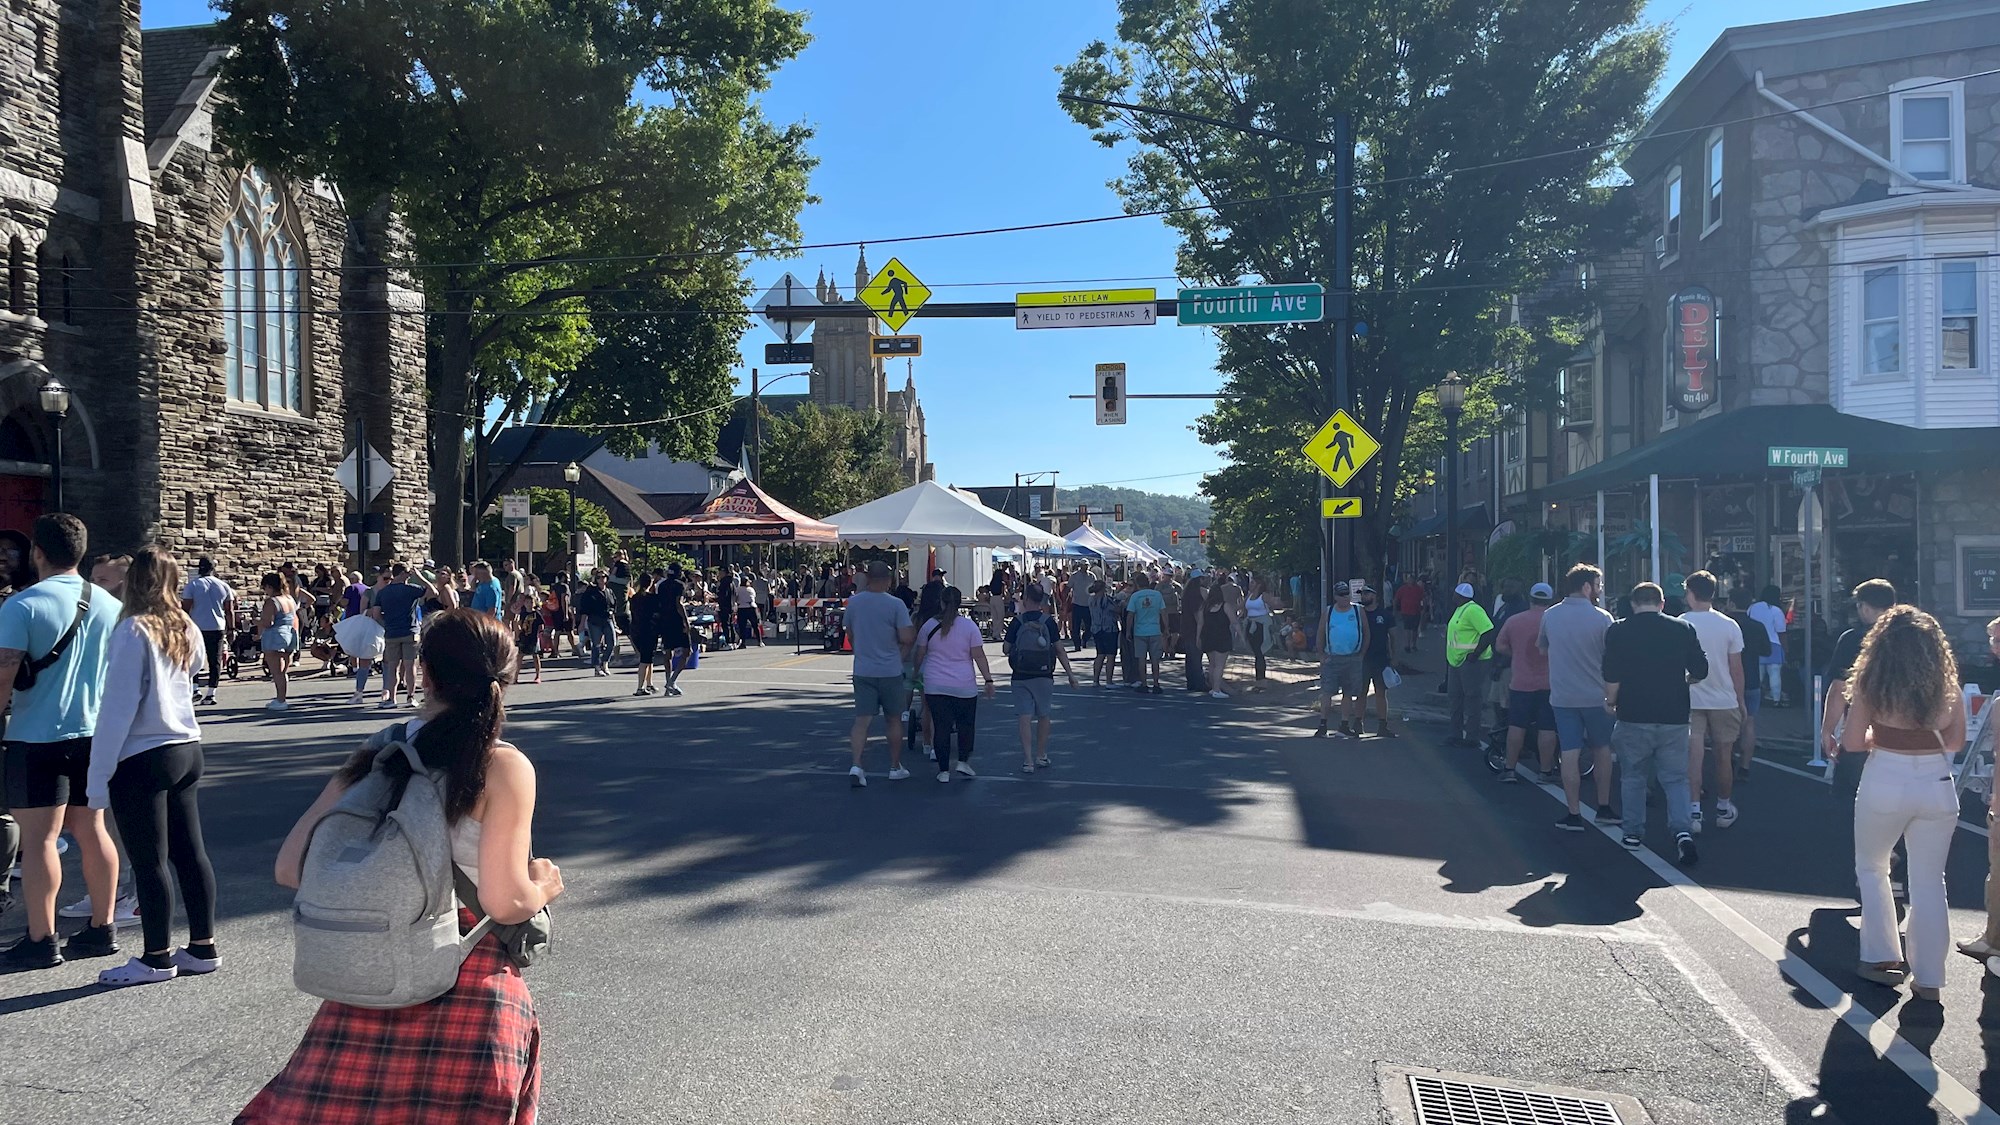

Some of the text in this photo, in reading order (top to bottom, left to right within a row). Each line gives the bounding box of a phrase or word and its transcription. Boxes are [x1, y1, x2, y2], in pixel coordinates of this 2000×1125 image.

[1062, 294, 1109, 303] STATE LAW
[1193, 290, 1307, 315] Fourth Ave
[1036, 310, 1136, 321] YIELD TO PEDESTRIANS
[1680, 302, 1709, 392] DELI
[1683, 393, 1695, 403] on
[1772, 449, 1844, 465] W Fourth Ave
[714, 496, 758, 507] LATIN
[704, 504, 757, 514] FLAVOR
